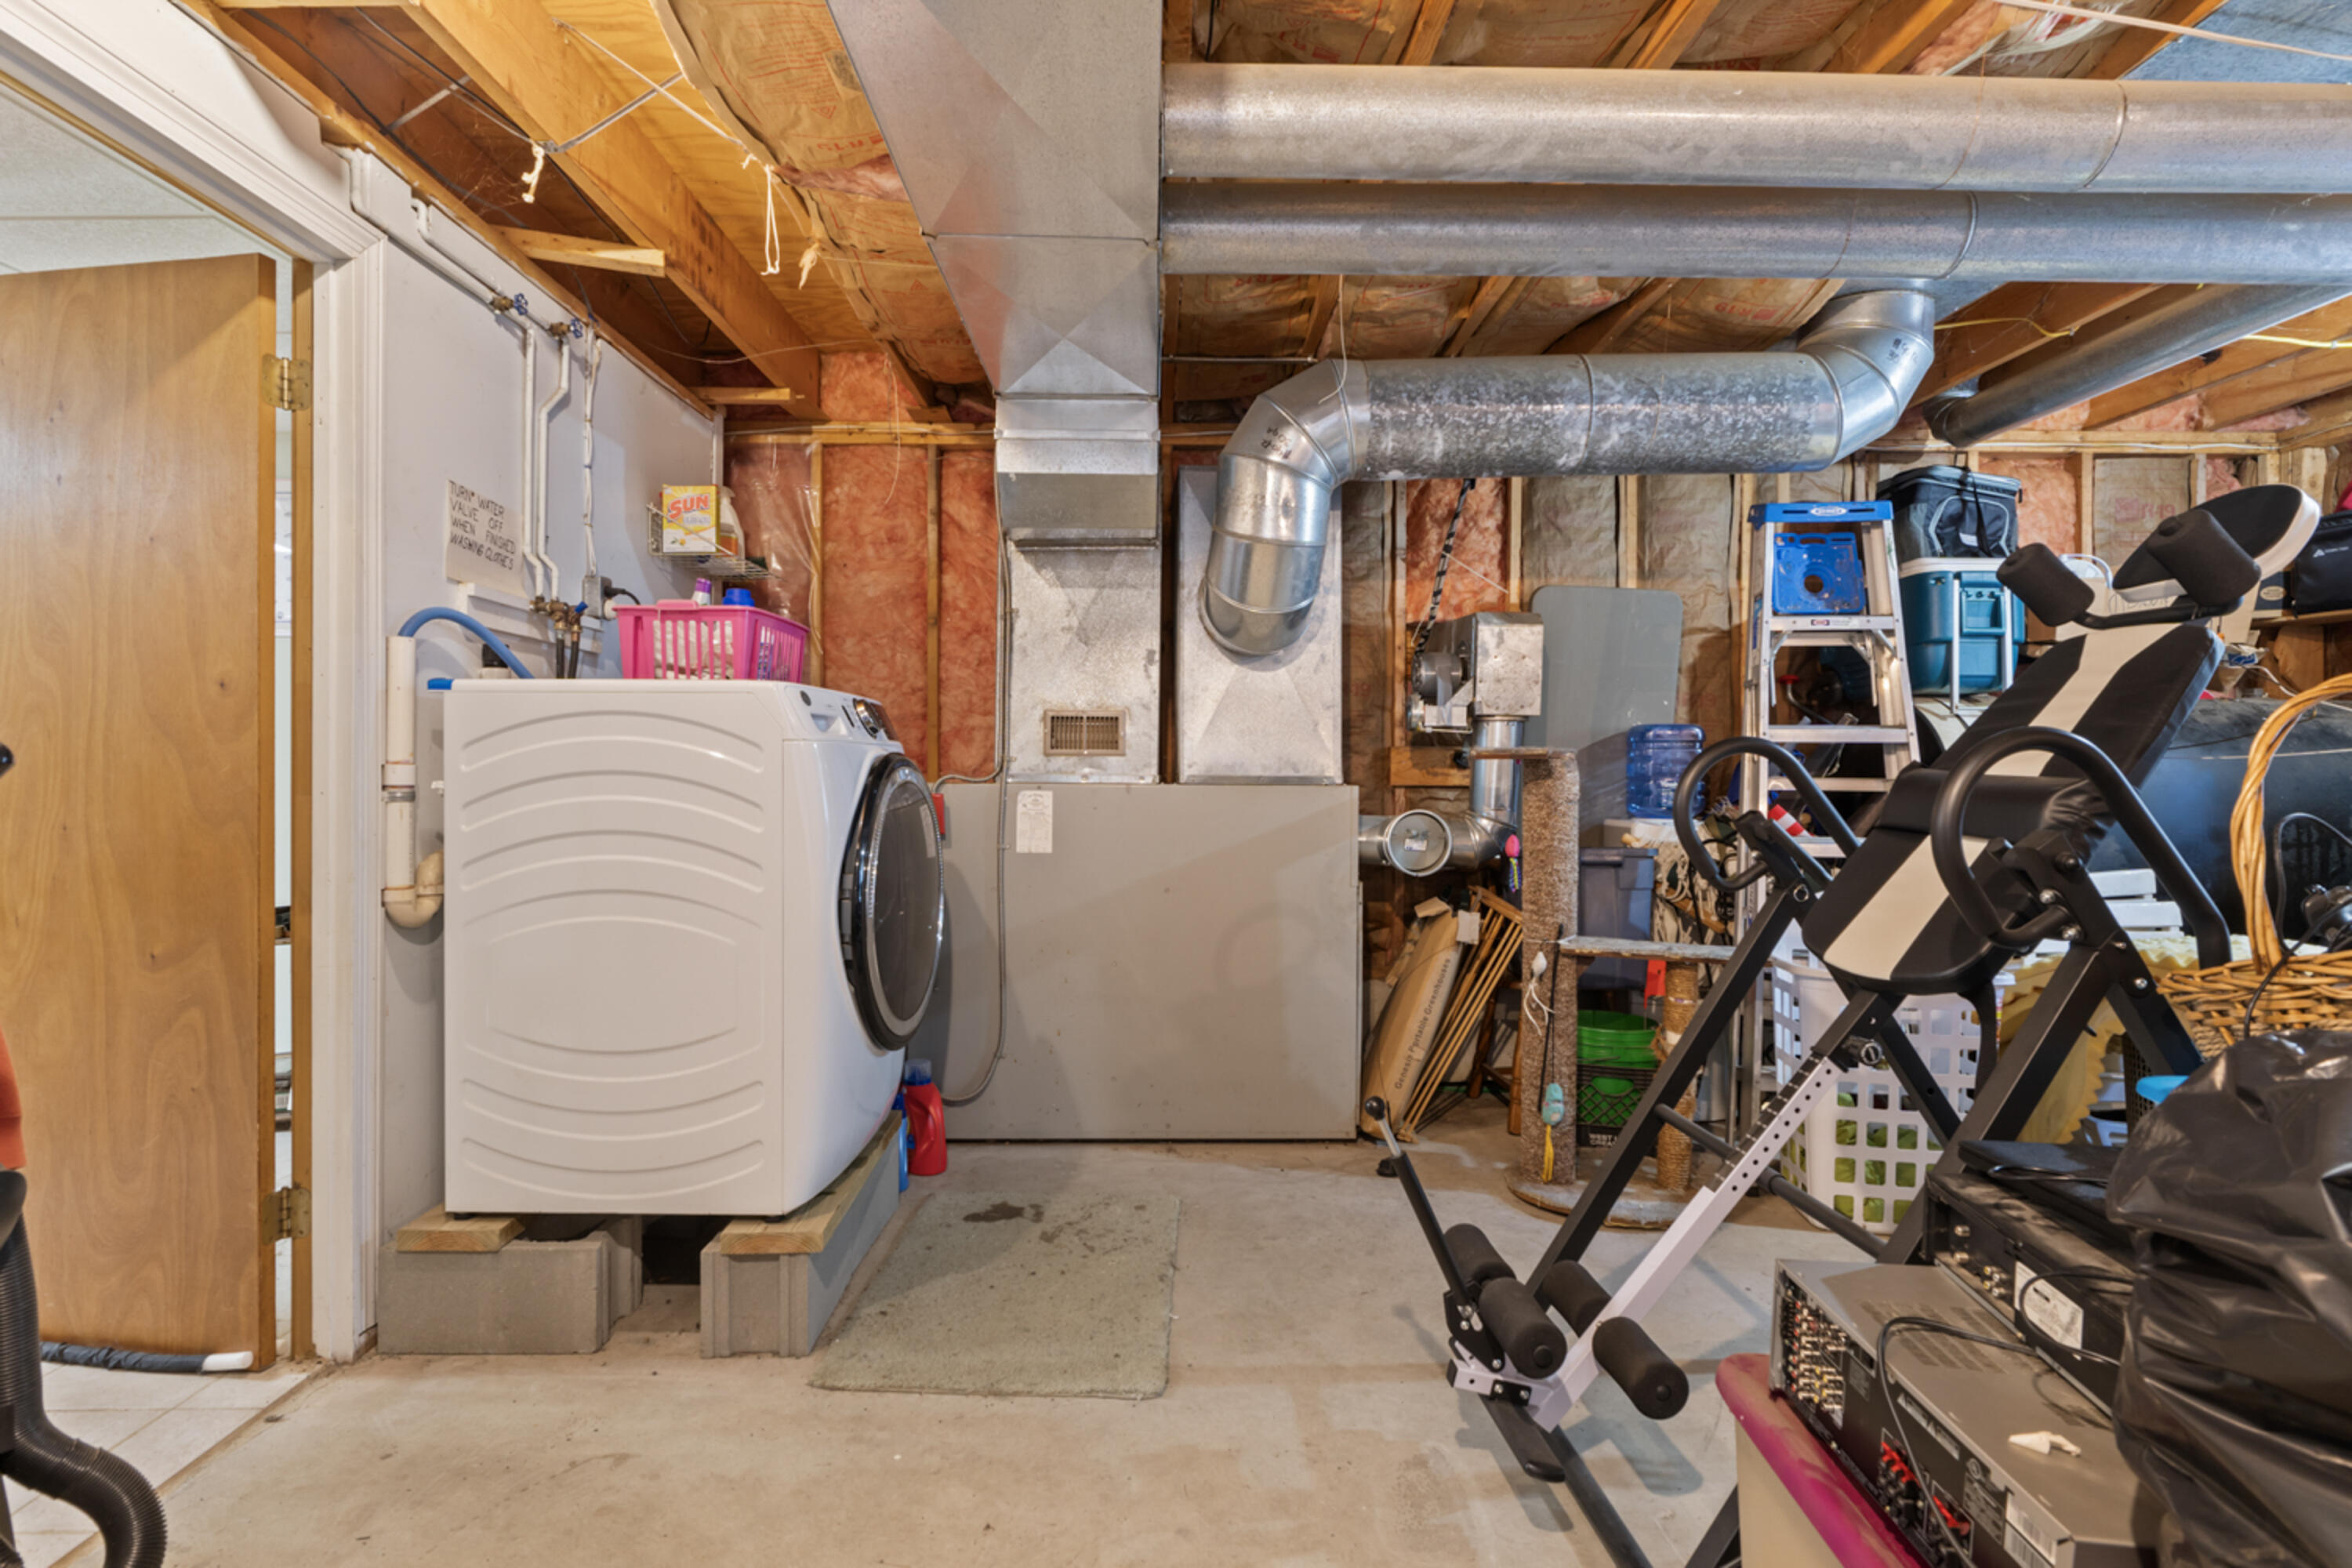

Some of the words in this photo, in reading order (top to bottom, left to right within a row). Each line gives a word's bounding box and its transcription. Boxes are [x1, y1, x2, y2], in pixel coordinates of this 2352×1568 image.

[448, 480, 471, 503] TURN
[477, 495, 504, 518] WATER
[449, 497, 479, 523] VALVE
[488, 517, 503, 533] OFF
[669, 494, 710, 521] SUN
[449, 532, 485, 557] WASHING
[485, 546, 514, 571] CLOTHES
[451, 514, 476, 535] WHEN
[485, 529, 516, 555] FINISHED
[1423, 957, 1451, 1016] Greenhouses
